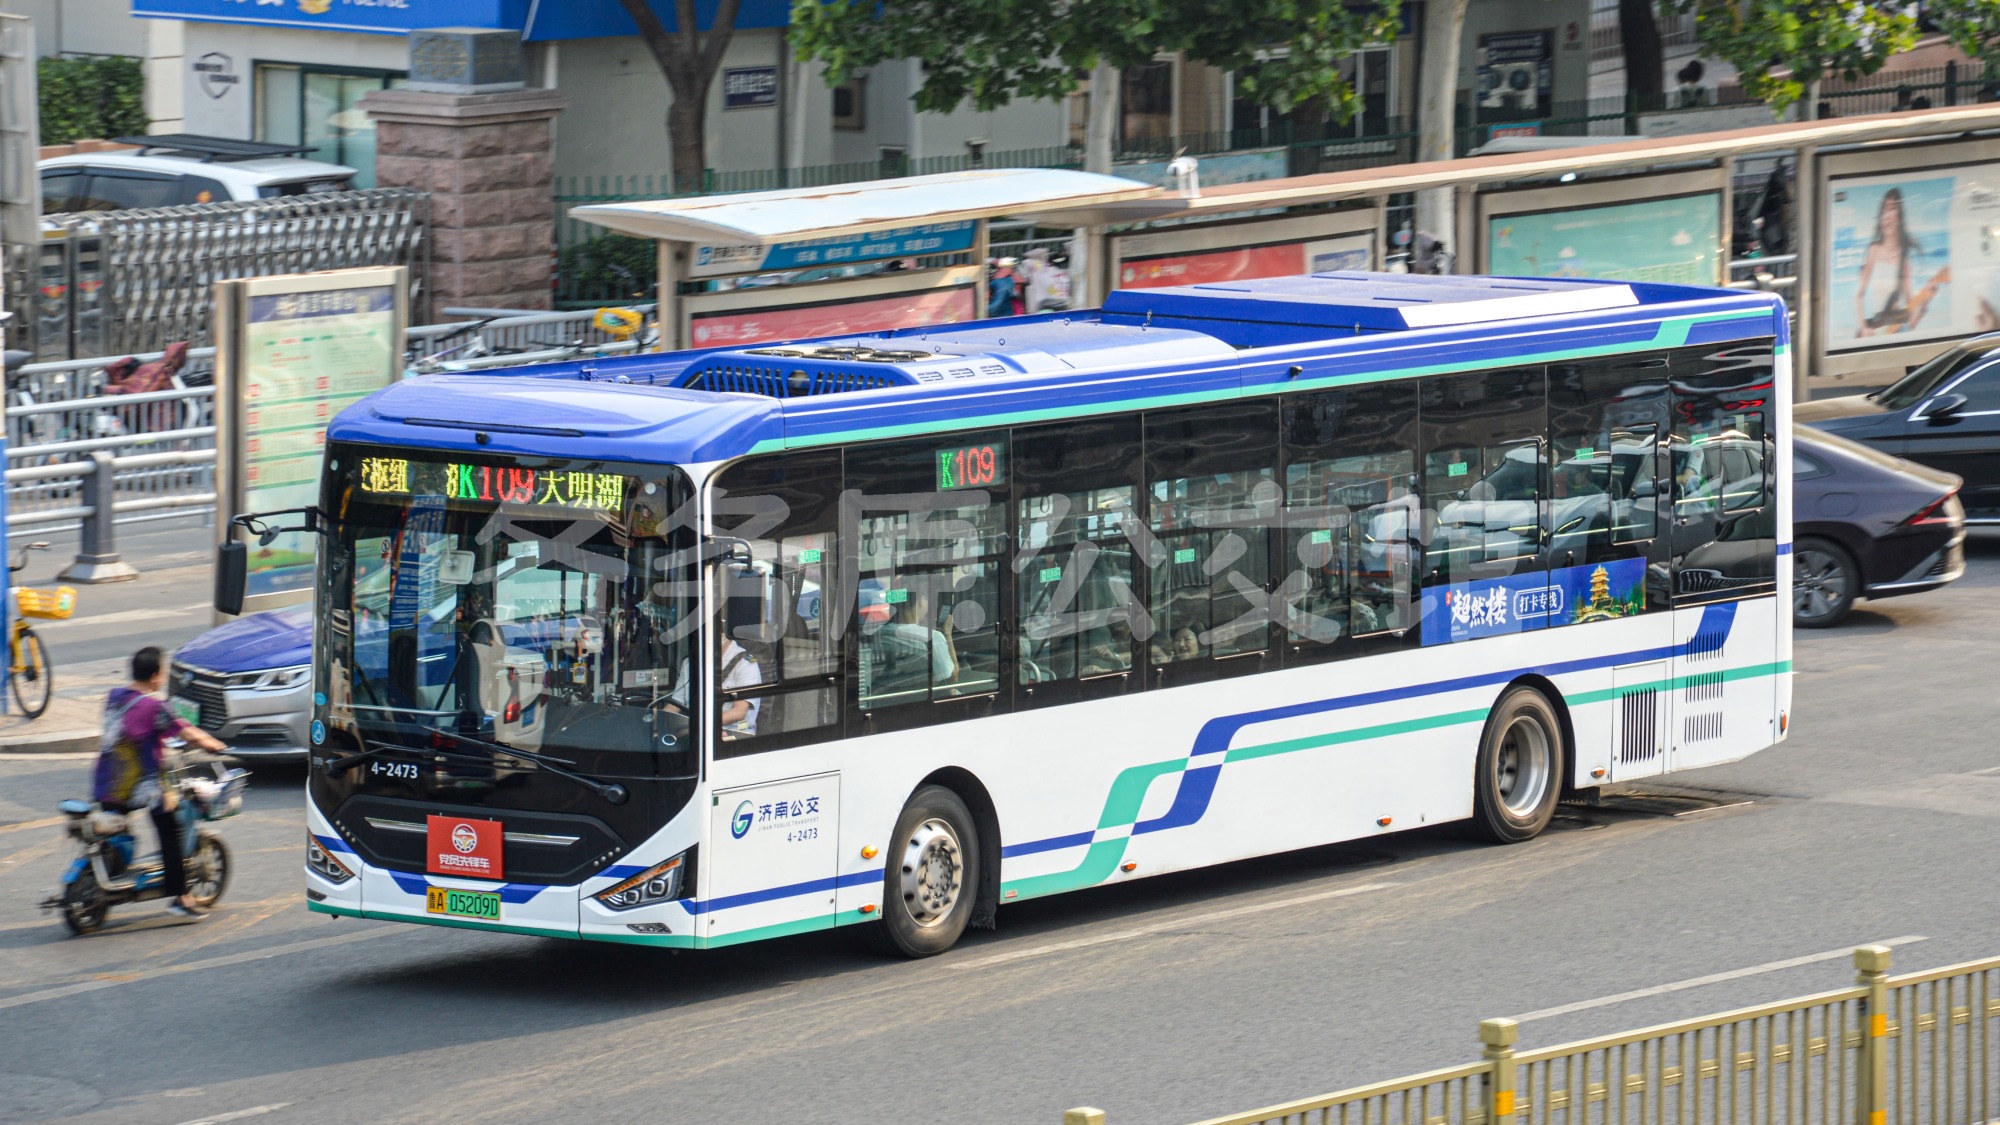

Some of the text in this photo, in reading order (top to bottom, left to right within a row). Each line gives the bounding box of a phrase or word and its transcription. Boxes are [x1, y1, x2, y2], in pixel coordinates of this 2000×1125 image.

[940, 445, 995, 488] K109
[537, 470, 624, 511] 大明湖
[1450, 585, 1507, 629] 超然楼
[1519, 591, 1558, 613] 打卡专线
[370, 761, 418, 779] 4-2473
[758, 796, 820, 823] 济南公交
[758, 816, 820, 832] JINAN PUBLIC TRANSPORT
[787, 827, 818, 843] 4-2473
[438, 853, 491, 869] 党员先锋车
[450, 893, 499, 916] 05209D
